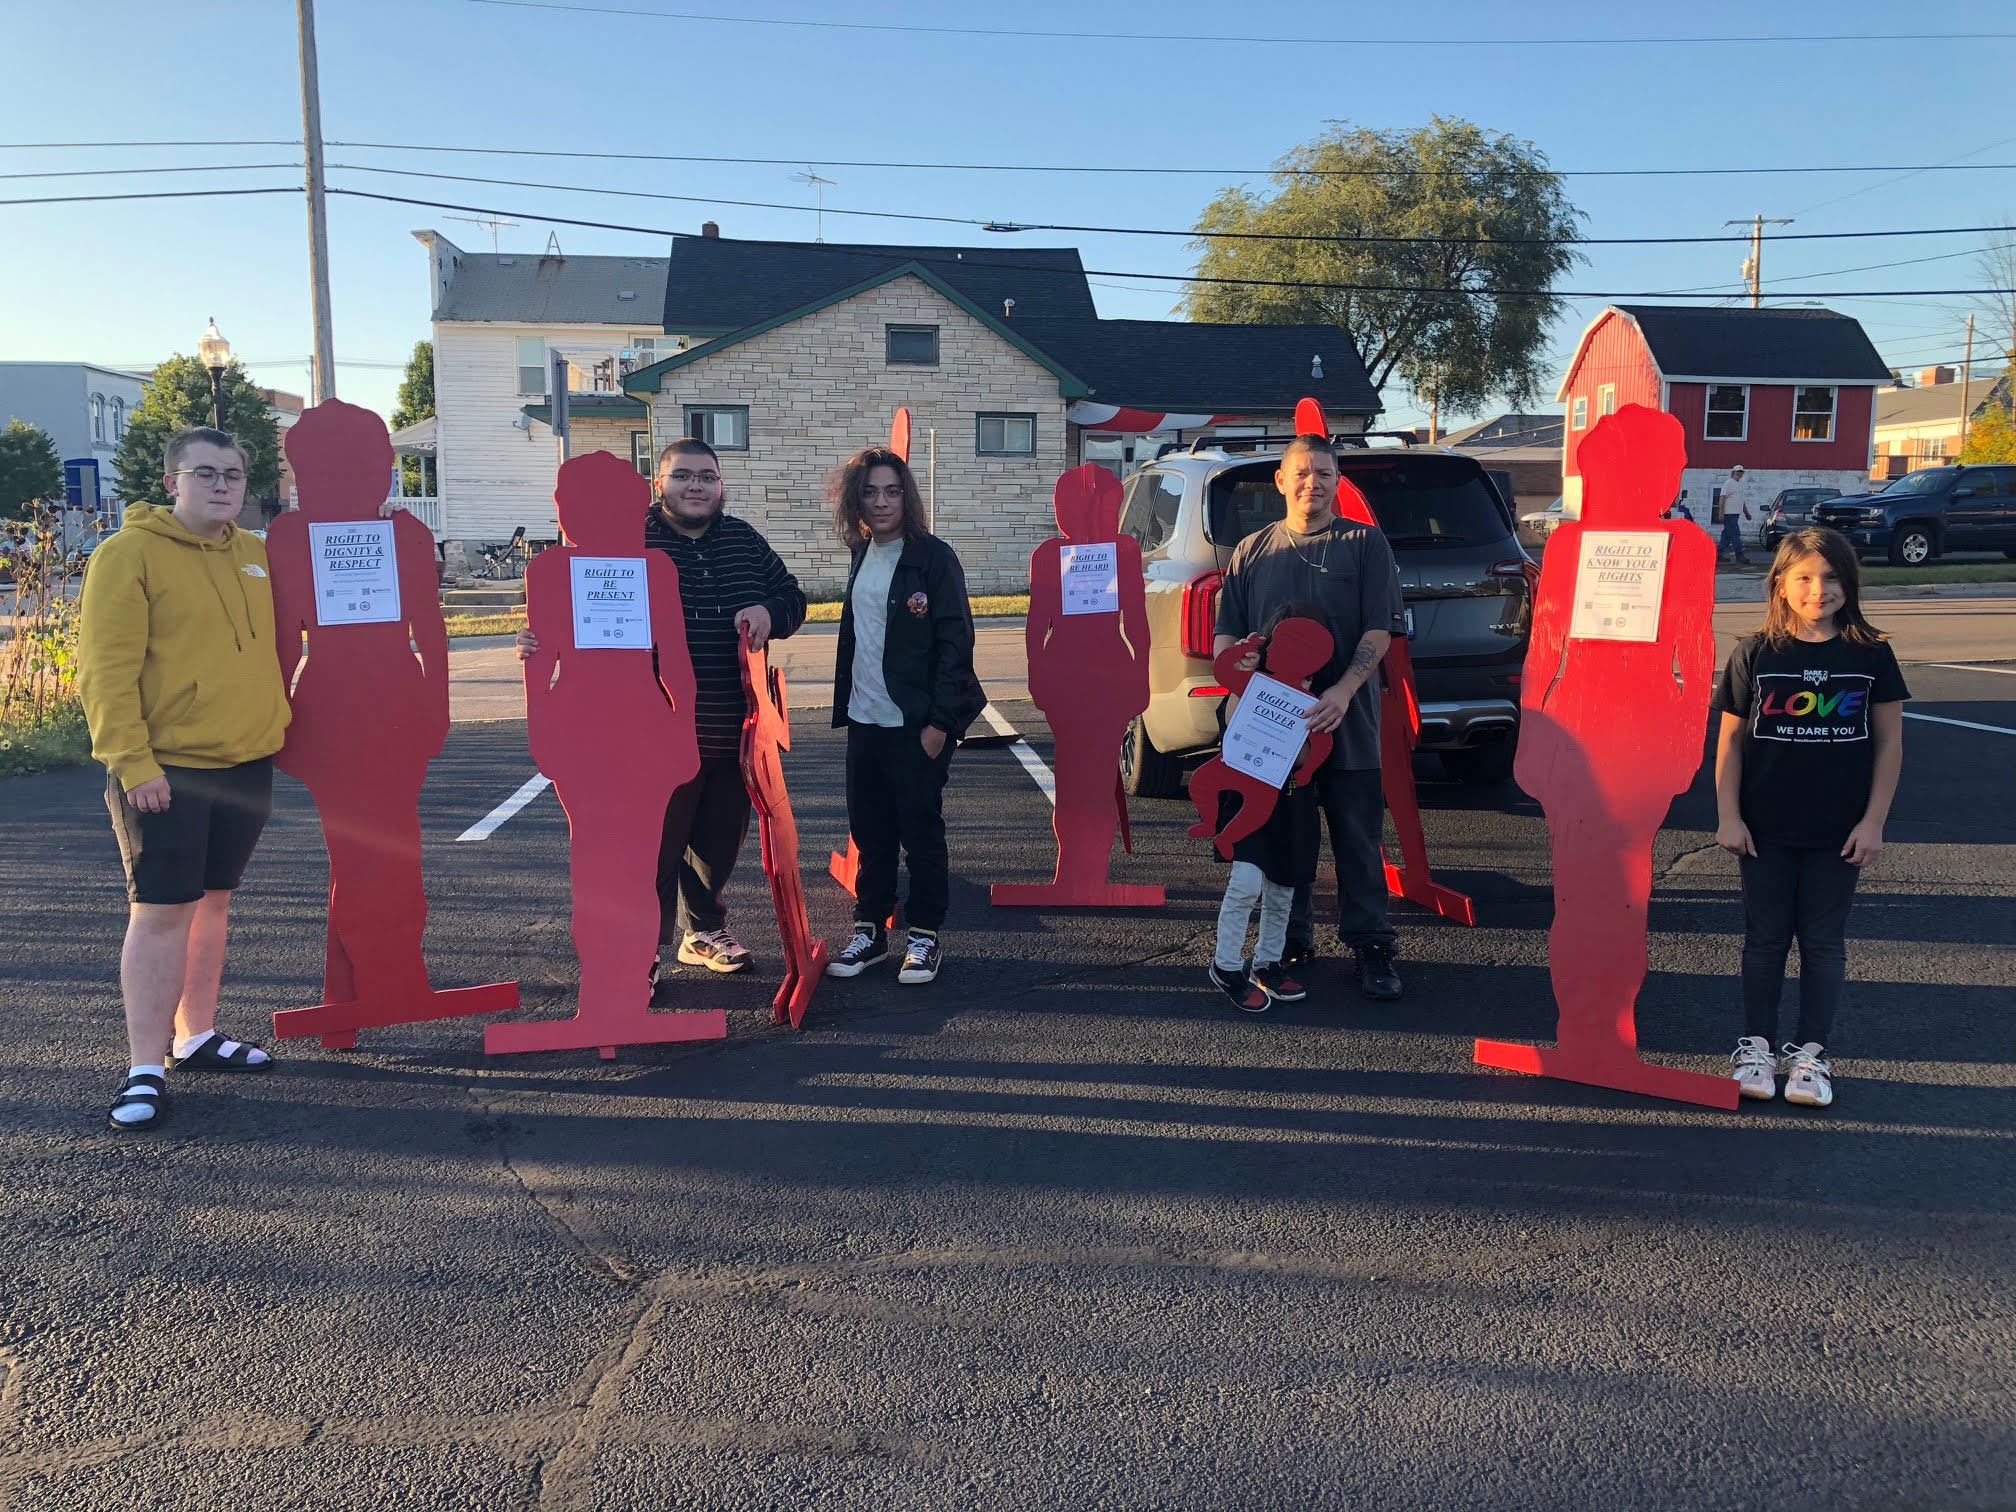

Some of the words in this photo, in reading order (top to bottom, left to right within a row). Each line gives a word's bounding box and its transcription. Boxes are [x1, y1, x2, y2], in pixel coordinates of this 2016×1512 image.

[325, 534, 362, 544] RIGHT
[365, 533, 380, 542] TO
[324, 546, 372, 557] DIGNITY
[375, 546, 383, 554] &
[1595, 545, 1634, 555] RIGHT
[1636, 545, 1652, 554] TO
[329, 558, 381, 569] RESPECT
[1081, 563, 1109, 571] HEARD
[1586, 558, 1622, 568] KNOW
[1626, 559, 1658, 569] YOUR
[584, 568, 618, 577] RIGHT
[621, 569, 635, 577] TO
[1598, 571, 1643, 581] RIGHTS
[603, 580, 617, 588] BE
[586, 591, 635, 599] PRESENT
[1803, 675, 1828, 685] KNOW
[1257, 690, 1292, 709] RIGHT
[1291, 704, 1306, 716] TO
[1762, 688, 1866, 717] LOVE
[1254, 705, 1296, 728] CONFER
[1776, 725, 1794, 735] WE
[1797, 726, 1829, 736] DARE
[1832, 726, 1855, 736] YOU
